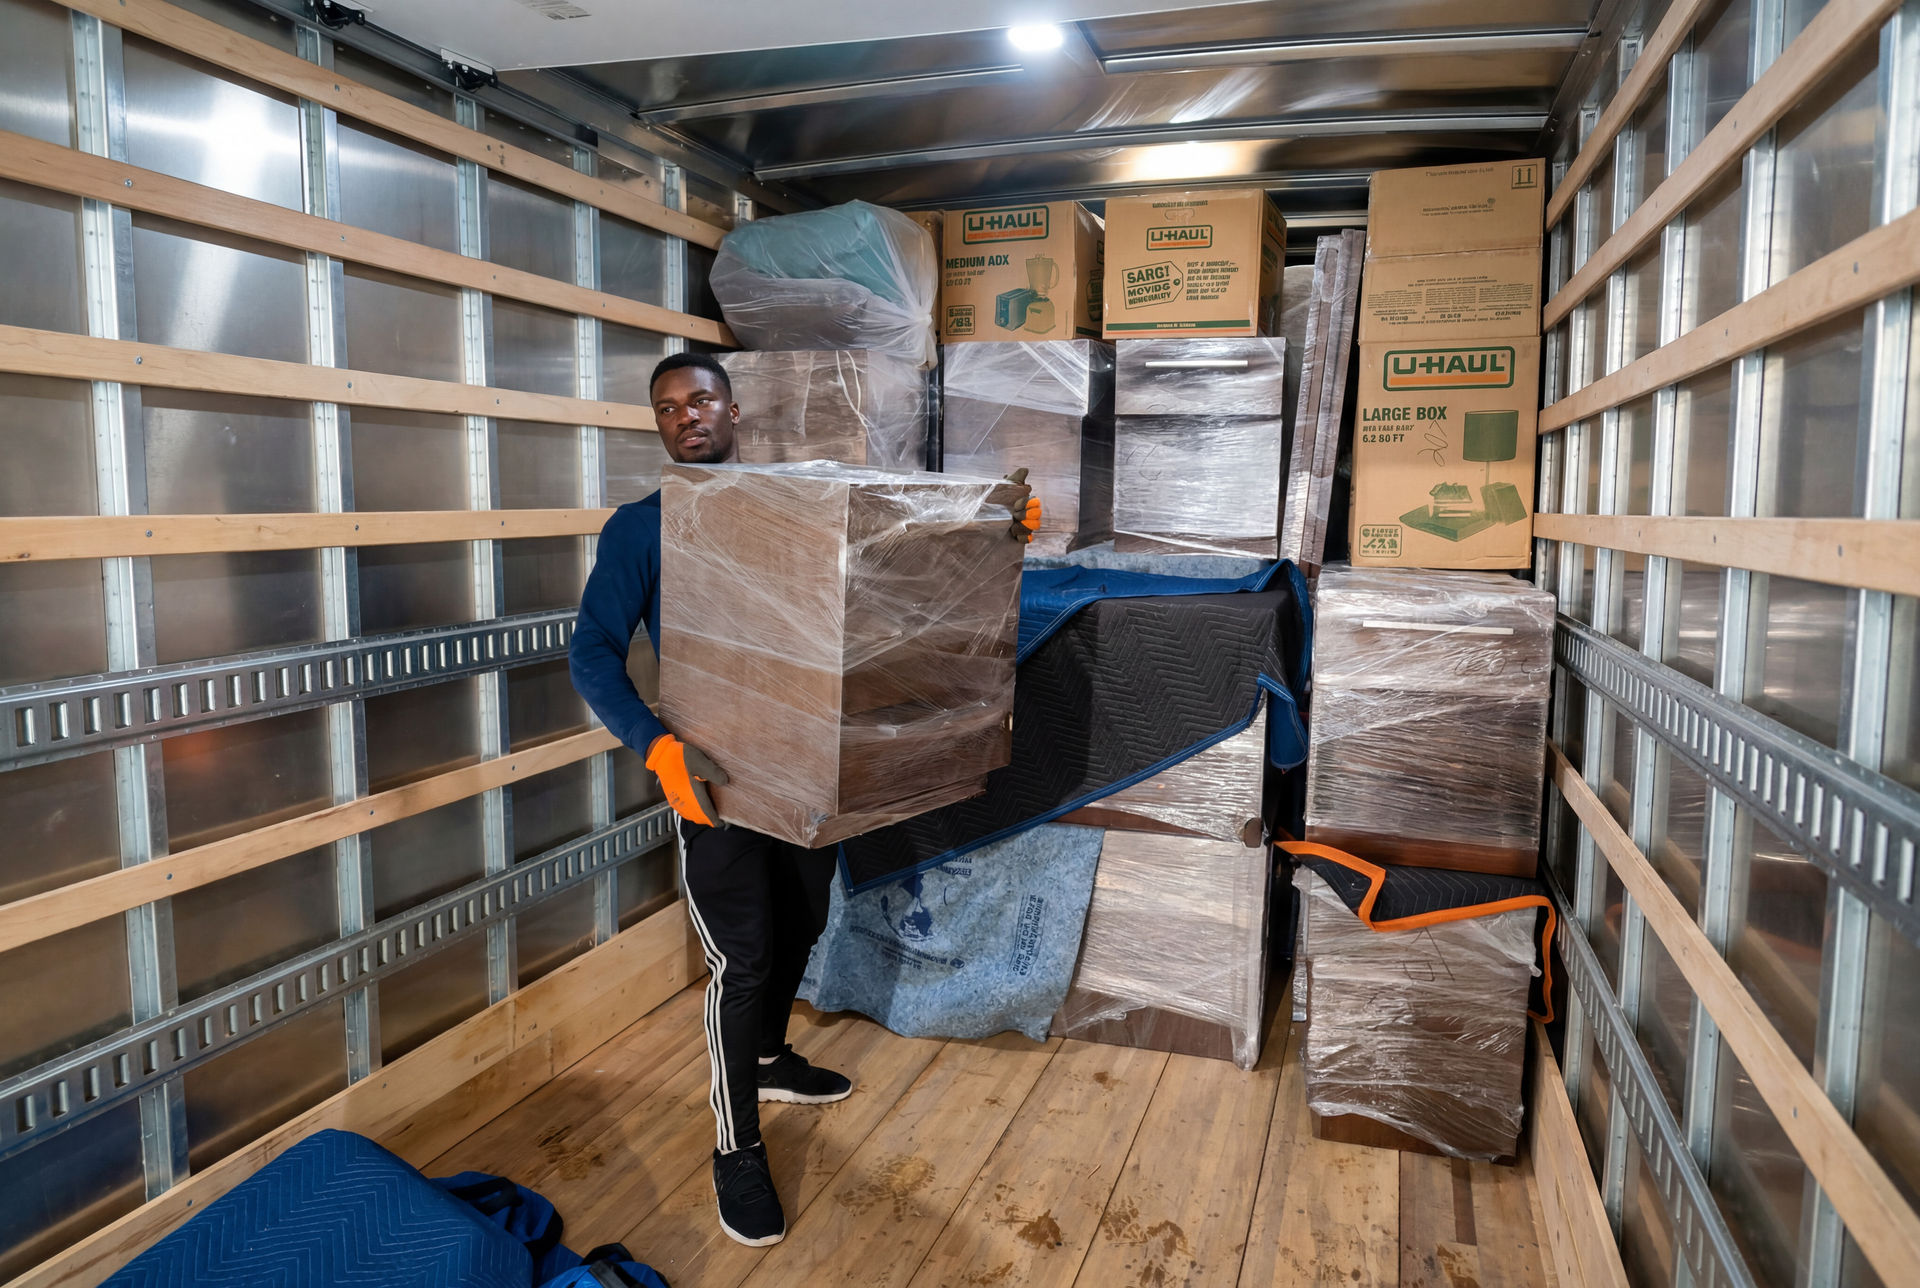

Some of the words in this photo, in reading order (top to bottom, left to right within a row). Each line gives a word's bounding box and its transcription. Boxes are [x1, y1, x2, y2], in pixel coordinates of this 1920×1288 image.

[968, 211, 1043, 231] U-HAUL
[1151, 229, 1208, 242] U-HAUL
[945, 256, 985, 269] MEDIUM
[1393, 354, 1505, 375] U-HAUL
[1363, 407, 1411, 421] LARGE
[1416, 406, 1448, 420] BOX
[1362, 433, 1377, 443] 6.2
[1379, 433, 1391, 443] 80
[1393, 433, 1405, 443] FT
